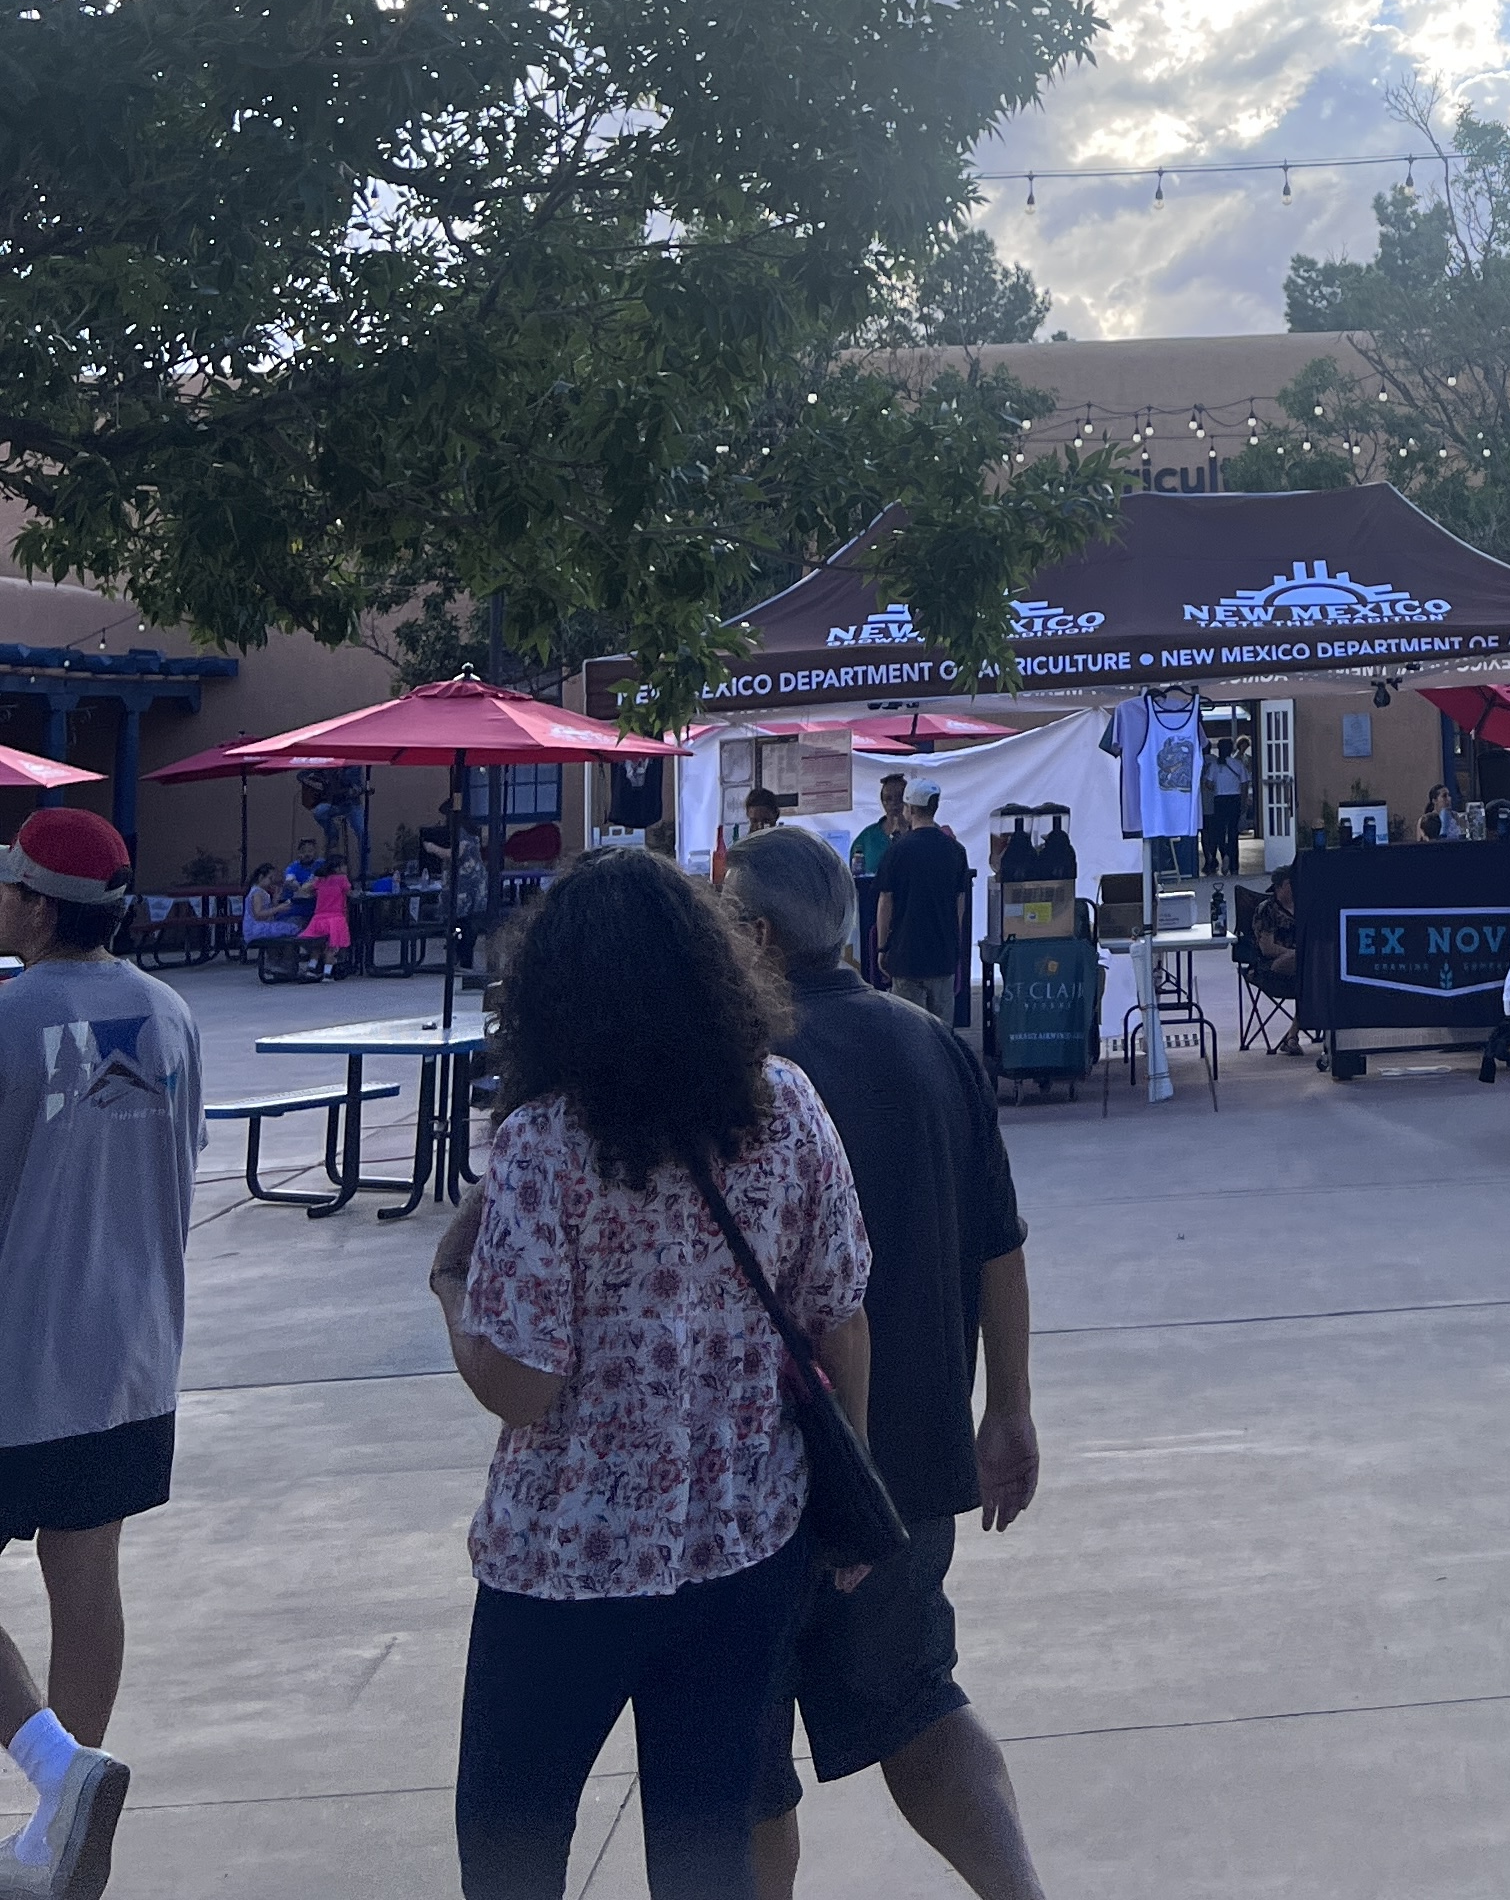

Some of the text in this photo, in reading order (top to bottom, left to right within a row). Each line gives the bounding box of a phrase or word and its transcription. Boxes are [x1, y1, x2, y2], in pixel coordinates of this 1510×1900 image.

[1183, 599, 1452, 621] NEW MEXICO
[694, 673, 773, 701] EXICO
[779, 661, 934, 693] DEPARTMENT
[977, 651, 1132, 679] ARICULTURE
[1161, 648, 1215, 668] NEW
[1221, 642, 1311, 664] MEXICO
[1317, 636, 1464, 660] DEPARTMENT
[1358, 927, 1405, 955] EX
